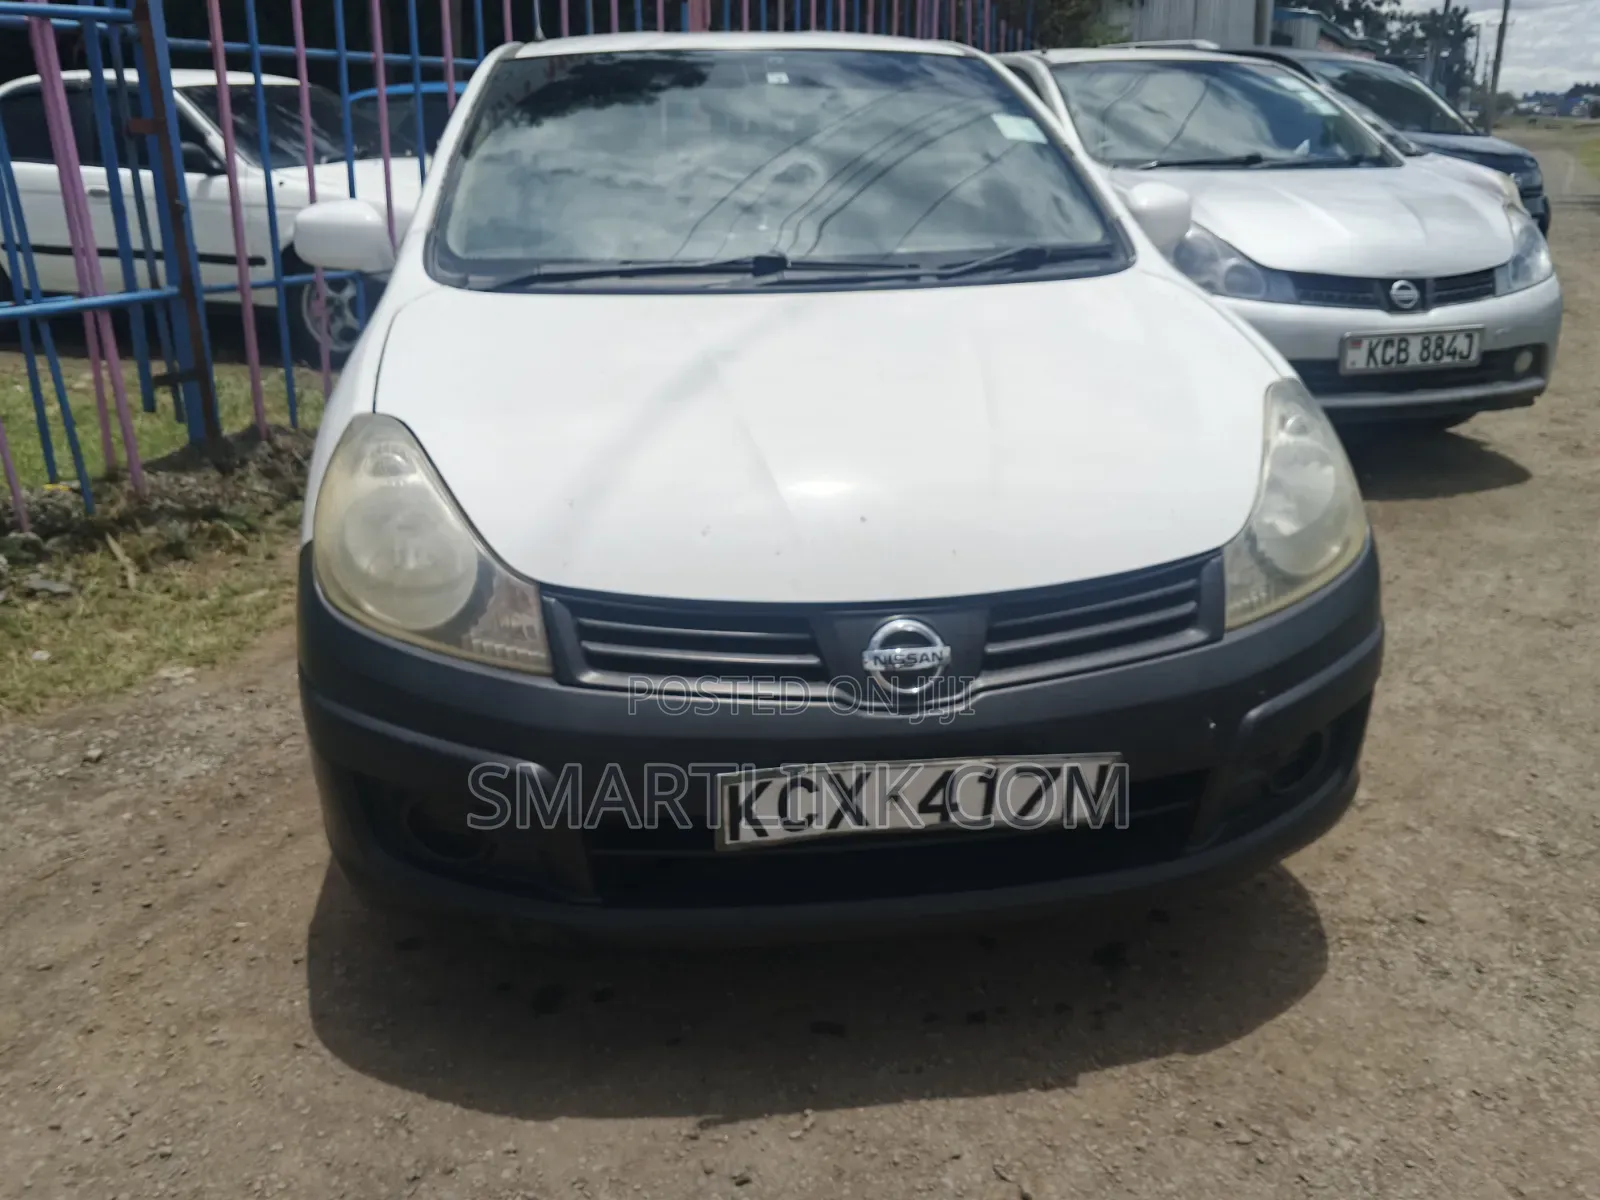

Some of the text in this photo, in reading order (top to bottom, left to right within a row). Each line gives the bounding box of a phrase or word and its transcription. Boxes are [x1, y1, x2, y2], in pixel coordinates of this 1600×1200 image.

[1366, 332, 1474, 367] KCB 884J
[873, 650, 943, 667] NISSAN
[728, 771, 872, 841] KCX
